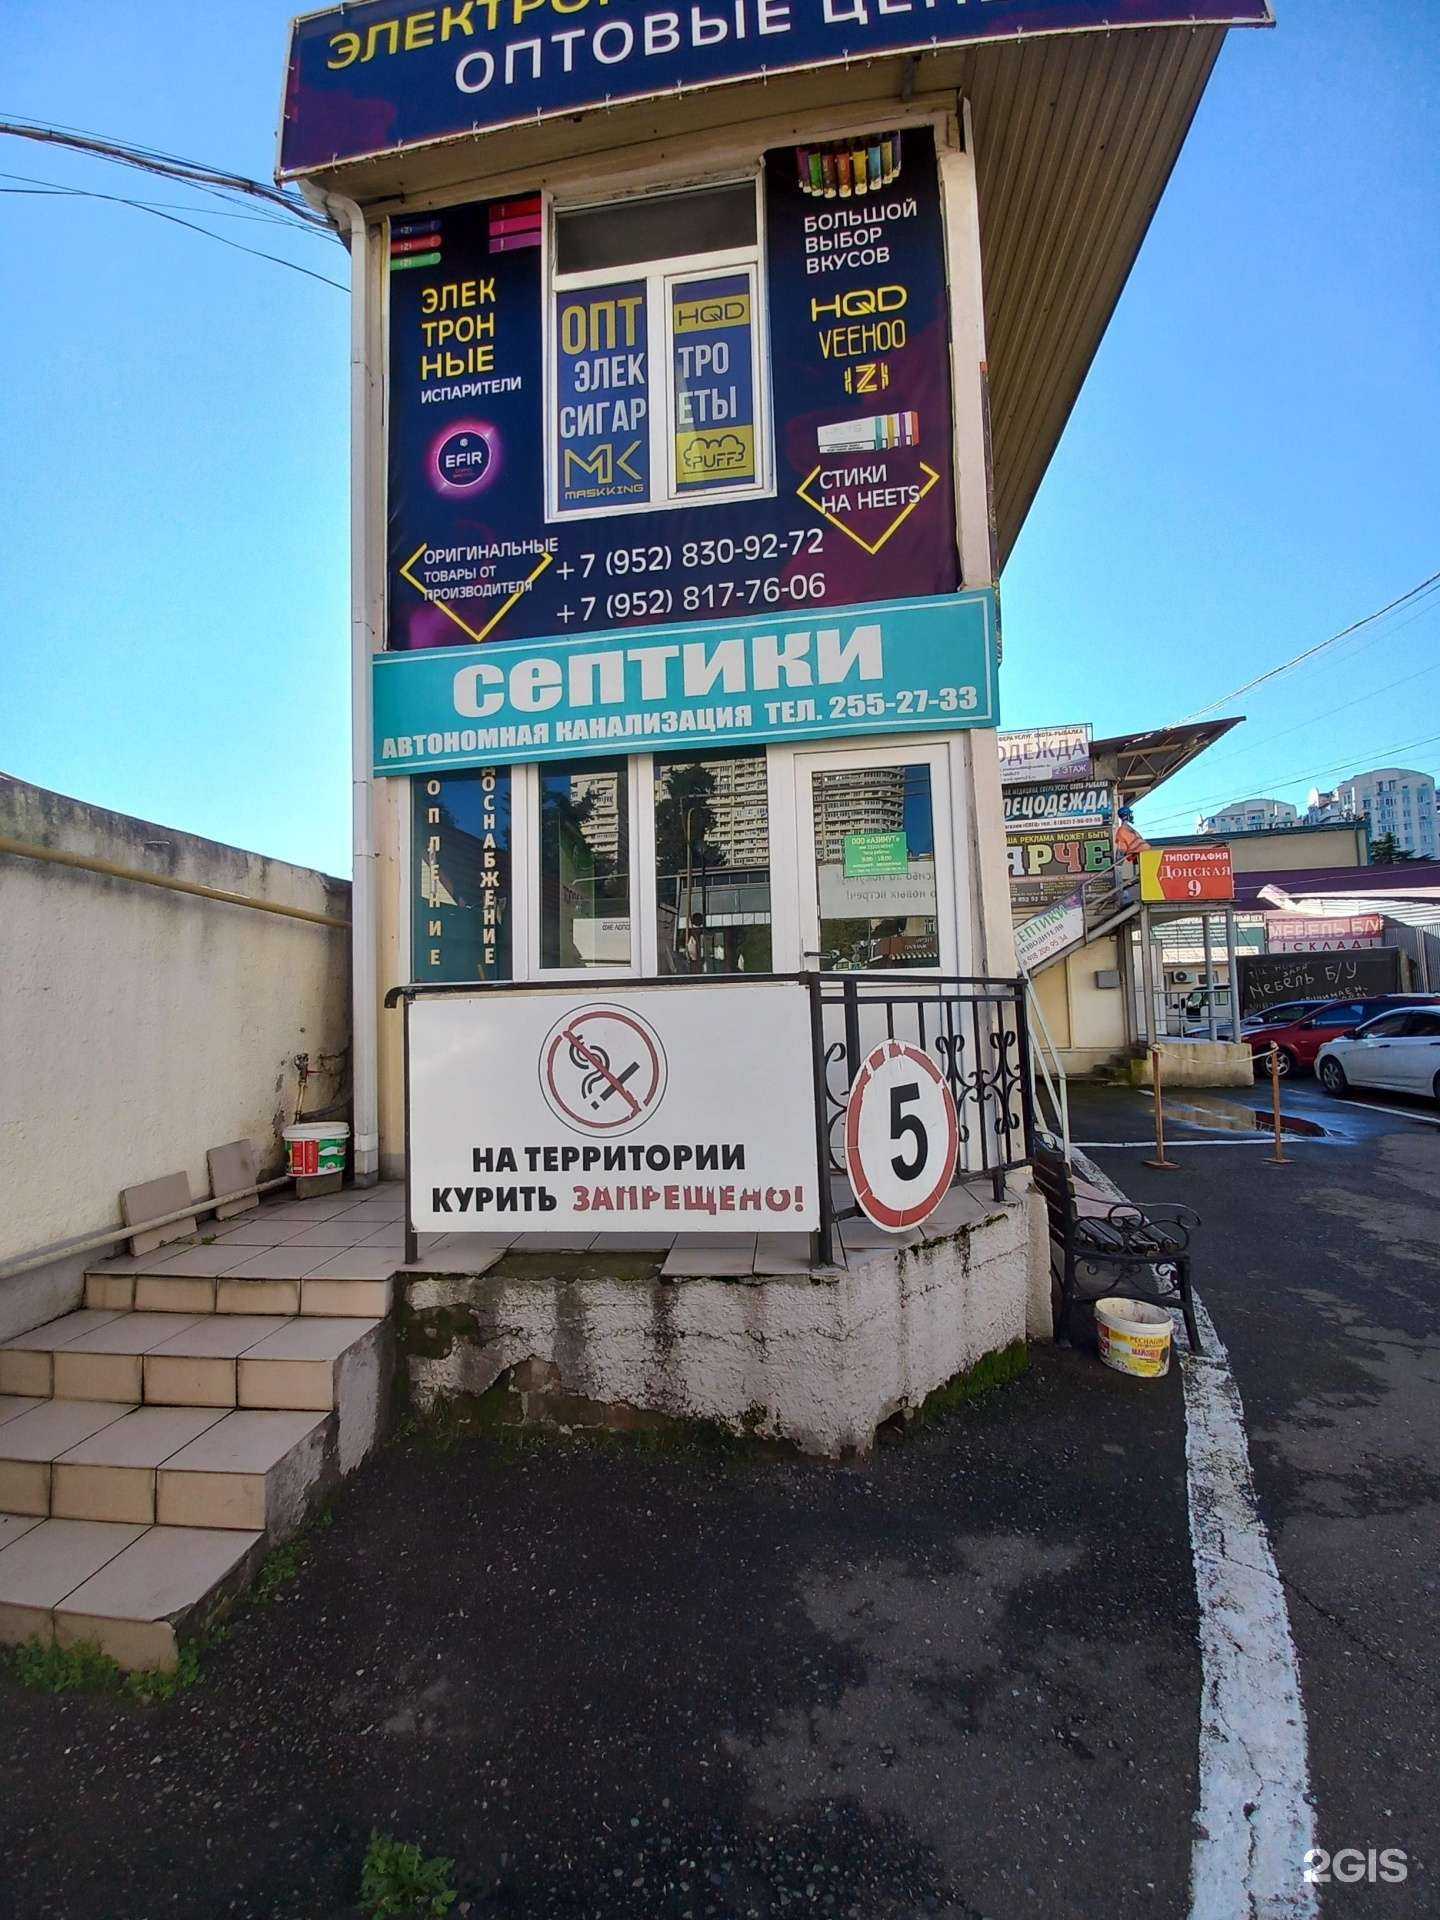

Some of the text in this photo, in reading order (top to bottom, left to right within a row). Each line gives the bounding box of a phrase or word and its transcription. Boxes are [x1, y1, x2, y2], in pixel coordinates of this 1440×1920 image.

[327, 0, 608, 69] ЭЛЕКТР
[455, 0, 791, 94] ОПТОВЫЕ
[805, 198, 917, 233] БОЛЬШОЙ
[806, 227, 882, 253] ВЫБОР
[807, 247, 890, 274] ВКУСОВ
[422, 277, 496, 314] ЭЛЕК
[811, 285, 907, 322] HQD
[421, 312, 495, 347] ТРОН
[561, 296, 643, 355] ОПТ
[678, 302, 745, 326] HQD
[819, 319, 906, 359] VEEHOO
[421, 345, 494, 380] НЫЕ
[574, 352, 646, 393] ЭЛЕК
[677, 342, 730, 378] ТРО
[421, 376, 522, 404] ИСПАРИТЕЛИ
[678, 386, 737, 425] ЕТЫ
[560, 398, 647, 439] СИГАР
[446, 451, 482, 468] EFIR
[820, 464, 887, 489] СТИКИ
[821, 485, 920, 514] НА HEETS
[424, 537, 558, 565] ОРИГИНАЛЬНЫЕ
[606, 546, 672, 576] (952)
[682, 528, 824, 568] 830-92-72
[424, 565, 497, 583] ТОВАРЫ ОТ
[424, 580, 533, 601] ПРОИЗВОДИТЕЛЯ
[606, 589, 673, 619] (952)
[683, 572, 826, 610] 817-76-06
[382, 686, 977, 759] АВТОНОМНАЯ КАНАЛИЗАЦИЯ ТЕЛ. 255-27-33
[1062, 764, 1087, 773] ЭТАЖ
[1020, 835, 1054, 843] РЕКЛАМА
[1057, 833, 1085, 842] МОЖЕТ
[1007, 839, 1111, 876] ЯРЧЕ
[1164, 852, 1229, 862] ТИПОГРАФИЯ
[1188, 880, 1202, 897] 9
[1269, 921, 1345, 939] МЕБЕЛЬ
[890, 1082, 928, 1181] 5
[472, 1144, 745, 1172] НА ТЕРРИТОРИИ
[432, 1185, 804, 1216] КУРИТЬ ЗАПРЕЩЕНО!
